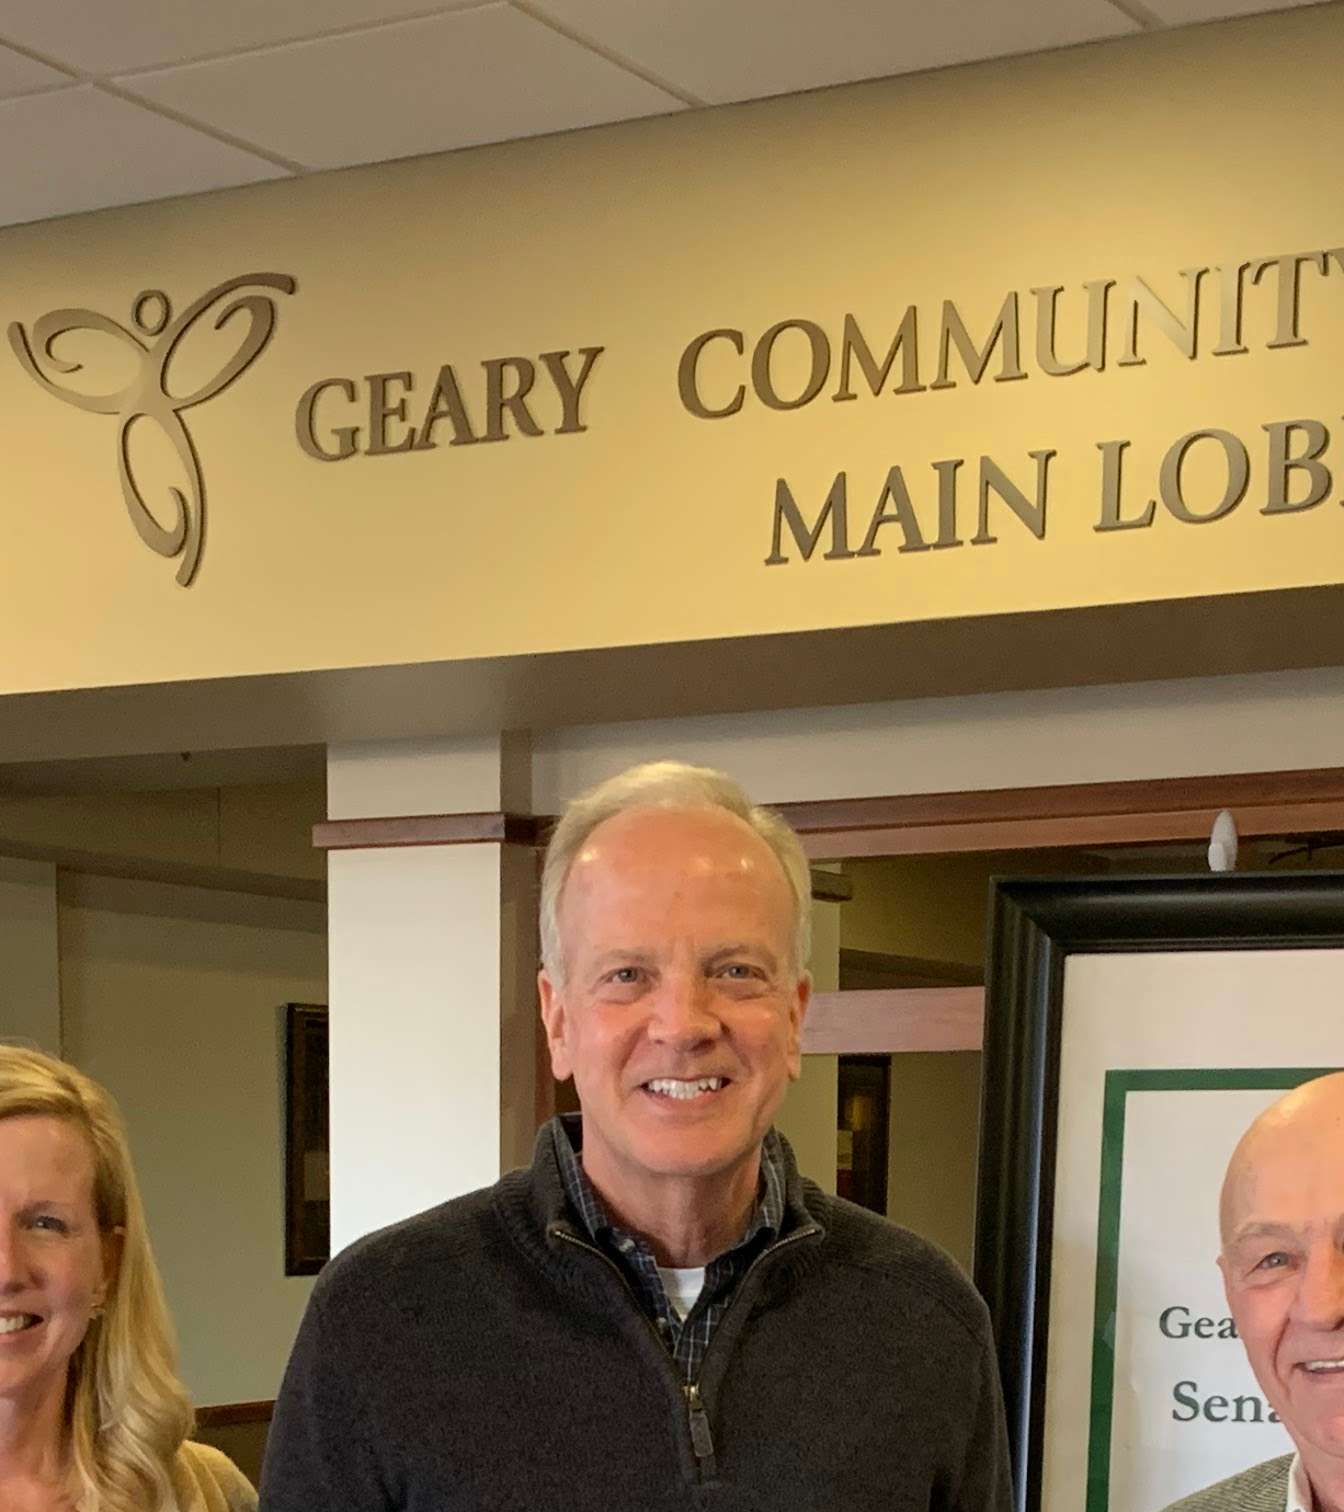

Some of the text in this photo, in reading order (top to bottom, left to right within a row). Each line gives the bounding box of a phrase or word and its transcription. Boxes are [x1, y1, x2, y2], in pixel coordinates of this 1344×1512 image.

[295, 346, 605, 463] GEARY
[764, 449, 1057, 566] MAIN
[1159, 1306, 1239, 1339] Gea
